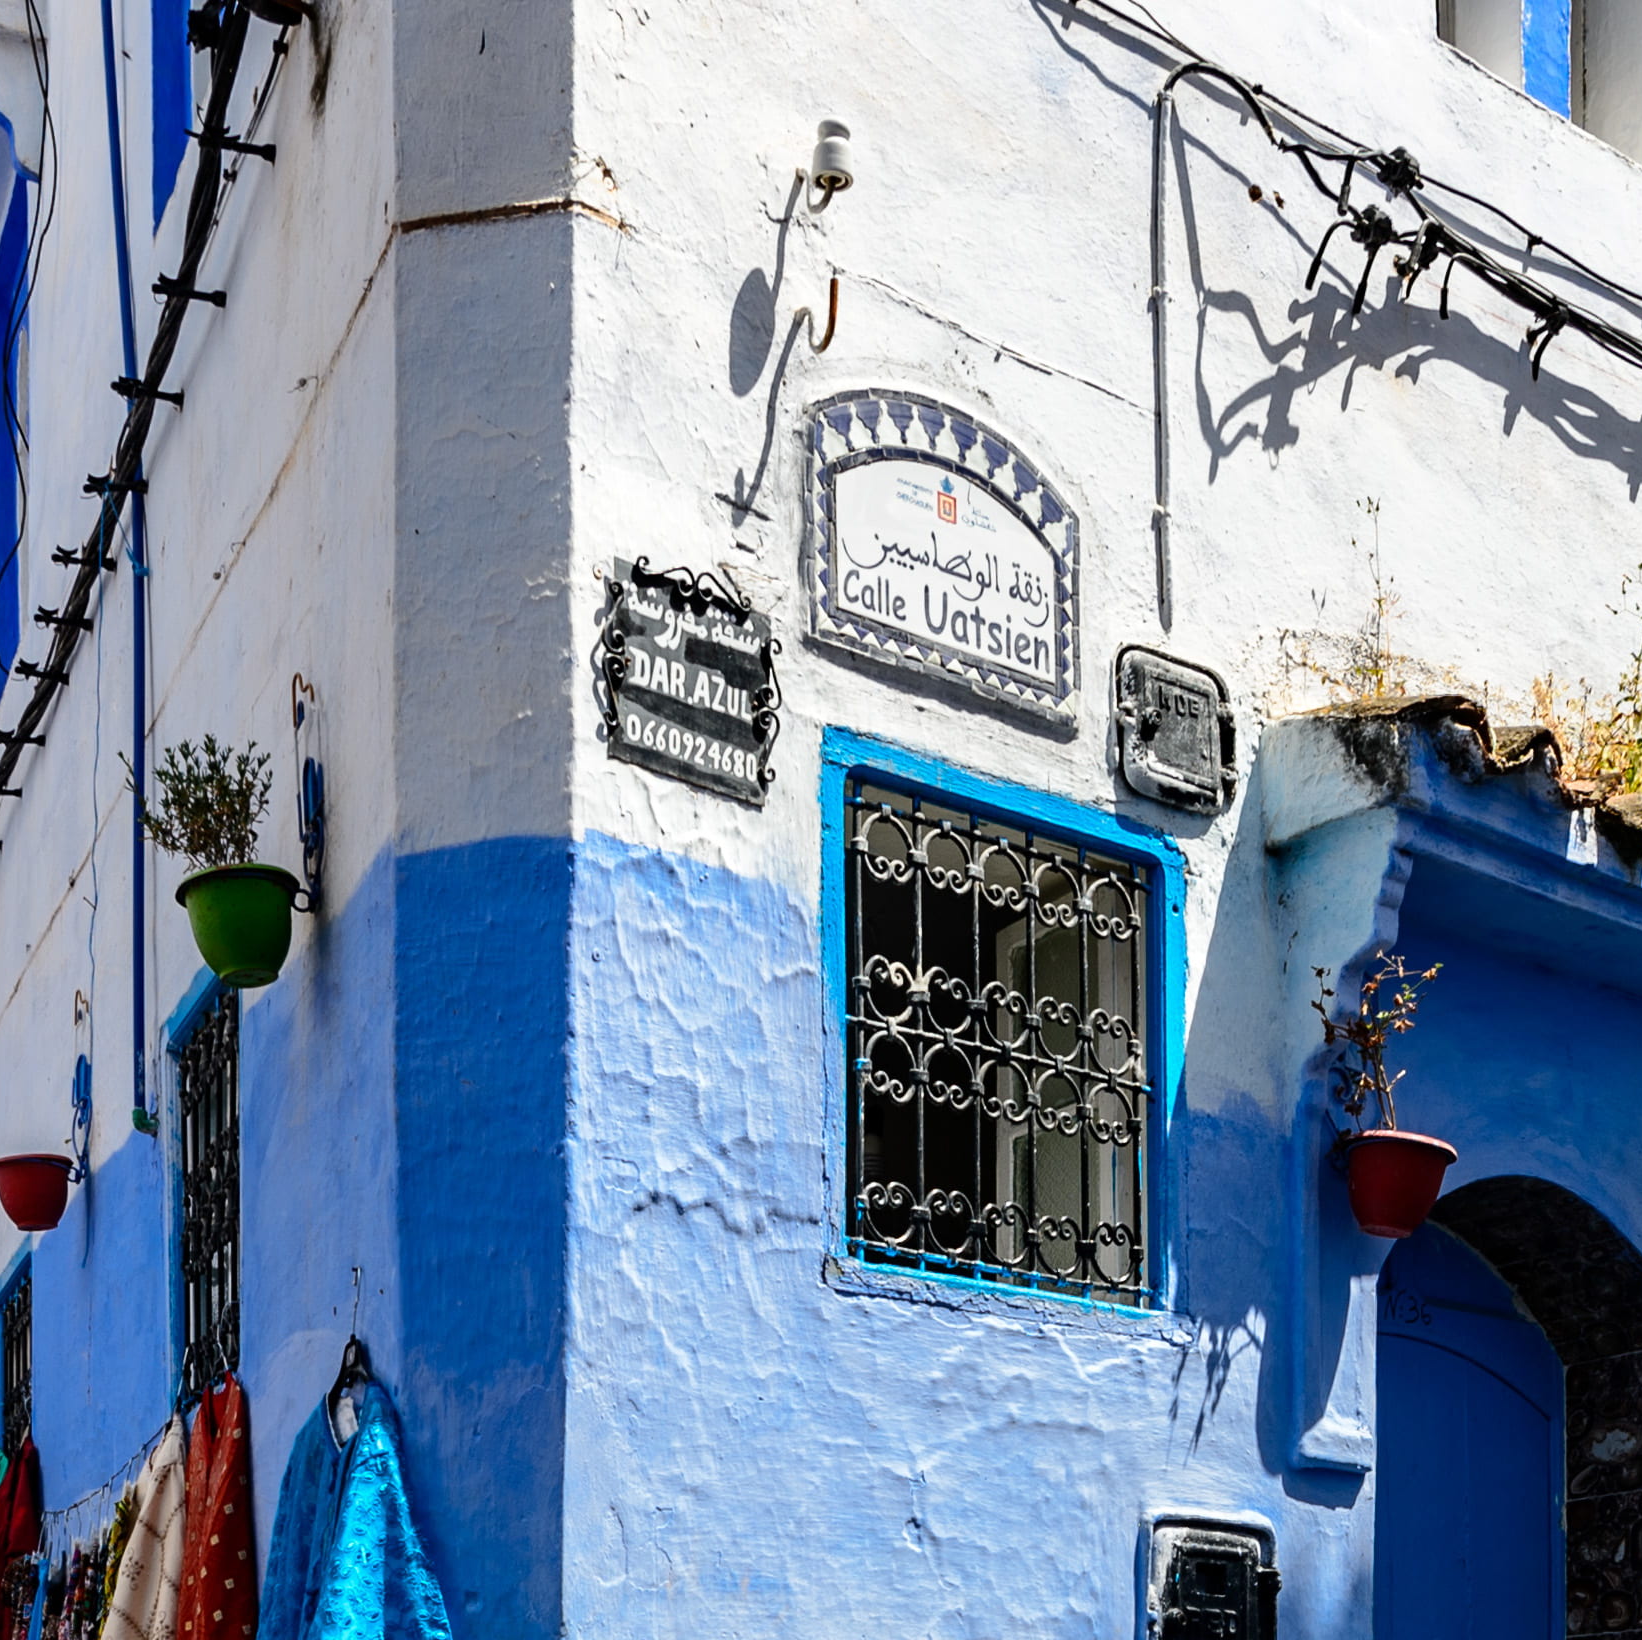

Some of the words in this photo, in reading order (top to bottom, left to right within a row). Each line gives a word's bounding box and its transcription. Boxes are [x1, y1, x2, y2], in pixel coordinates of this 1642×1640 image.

[843, 569, 906, 621] Calle
[924, 584, 1050, 675] Uatsien
[1009, 563, 1049, 627] زنقة
